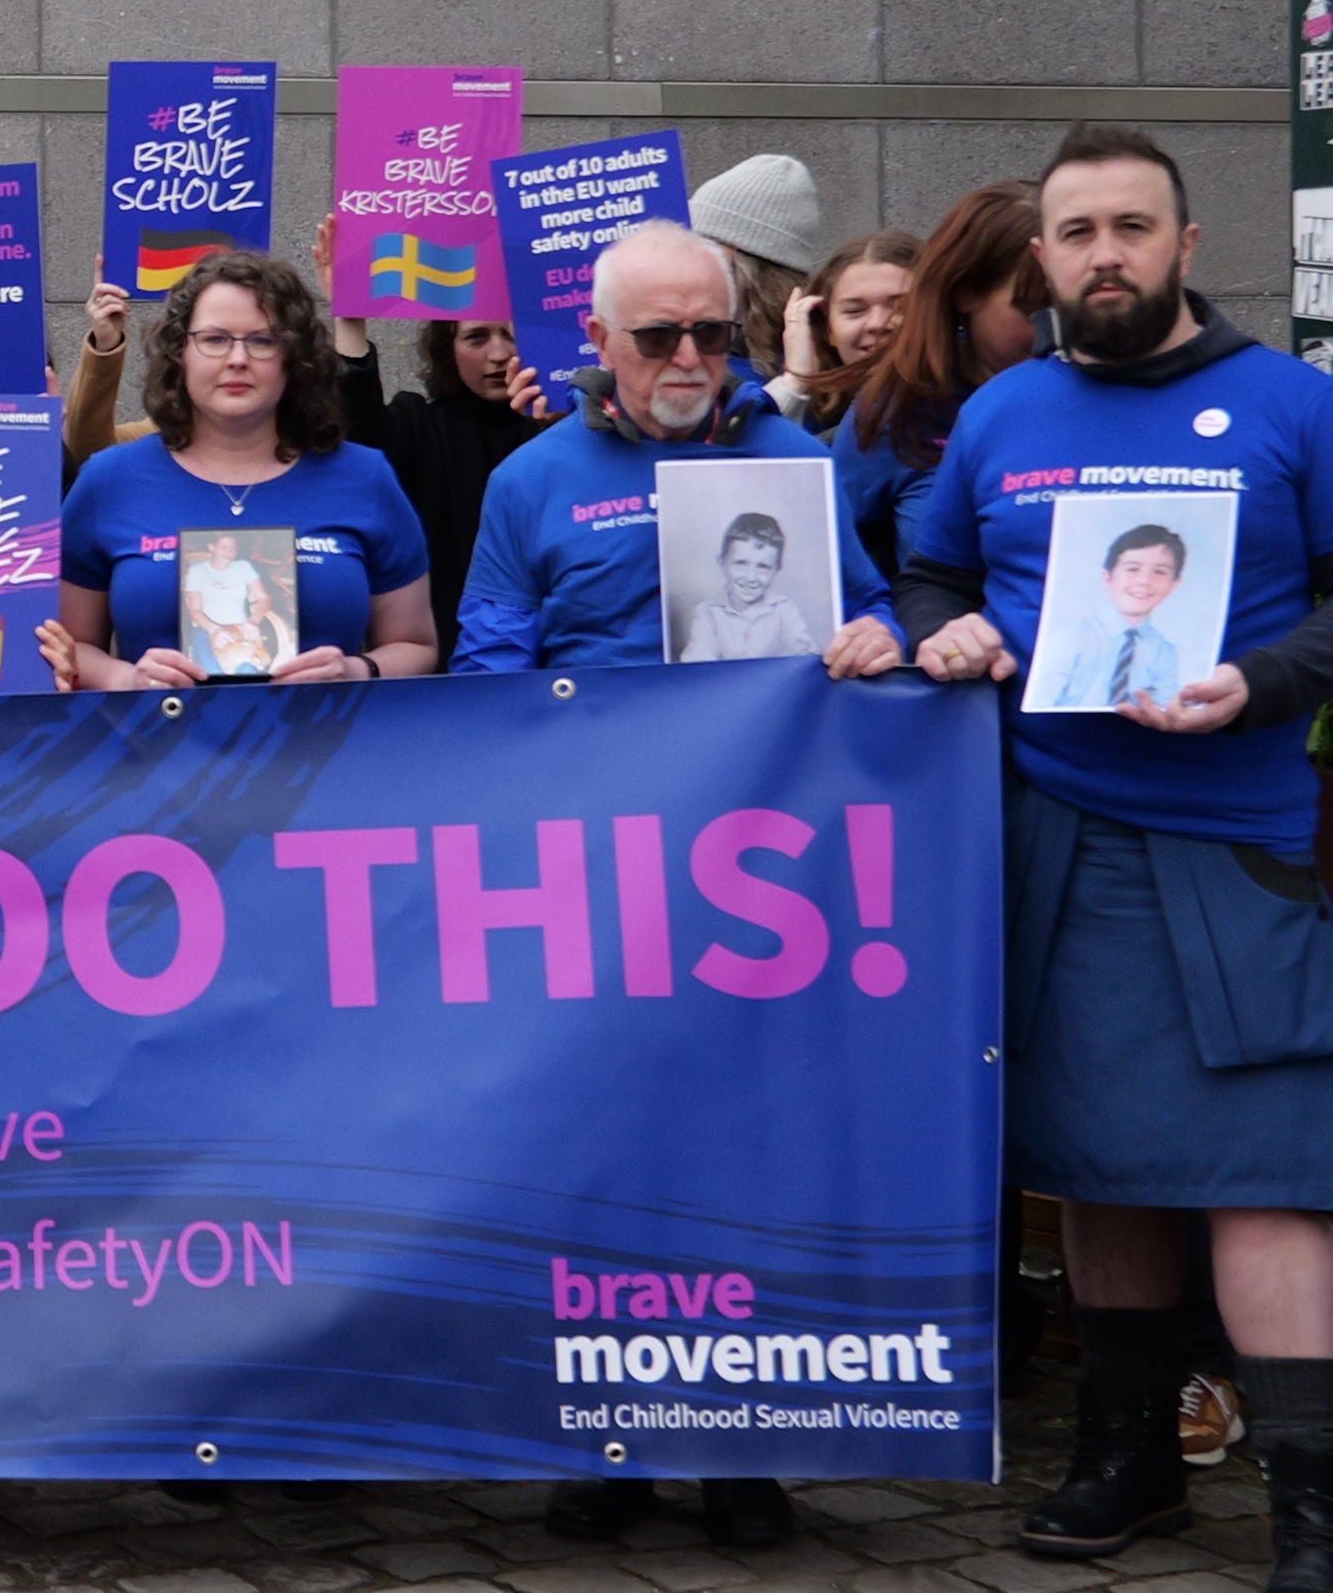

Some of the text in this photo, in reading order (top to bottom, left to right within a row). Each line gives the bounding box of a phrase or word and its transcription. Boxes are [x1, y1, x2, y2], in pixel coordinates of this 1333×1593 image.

[213, 75, 267, 84] movement
[147, 97, 238, 140] #BE
[396, 122, 463, 154] #BE
[133, 136, 251, 179] BRAVE
[385, 156, 473, 187] BRAVE
[504, 147, 668, 189] 7 out of 10 adults
[112, 177, 264, 214] SCHOLZ
[519, 171, 660, 210] in the EU want
[540, 195, 645, 229] more child
[531, 228, 592, 255] safety
[545, 267, 573, 288] EU
[1002, 465, 1245, 493] brave movement
[571, 495, 644, 523] brave
[273, 803, 909, 1008] THIS!
[550, 1256, 756, 1321] brave
[553, 1323, 955, 1385] movement
[559, 1403, 961, 1432] End Childhood Sexual Violence
